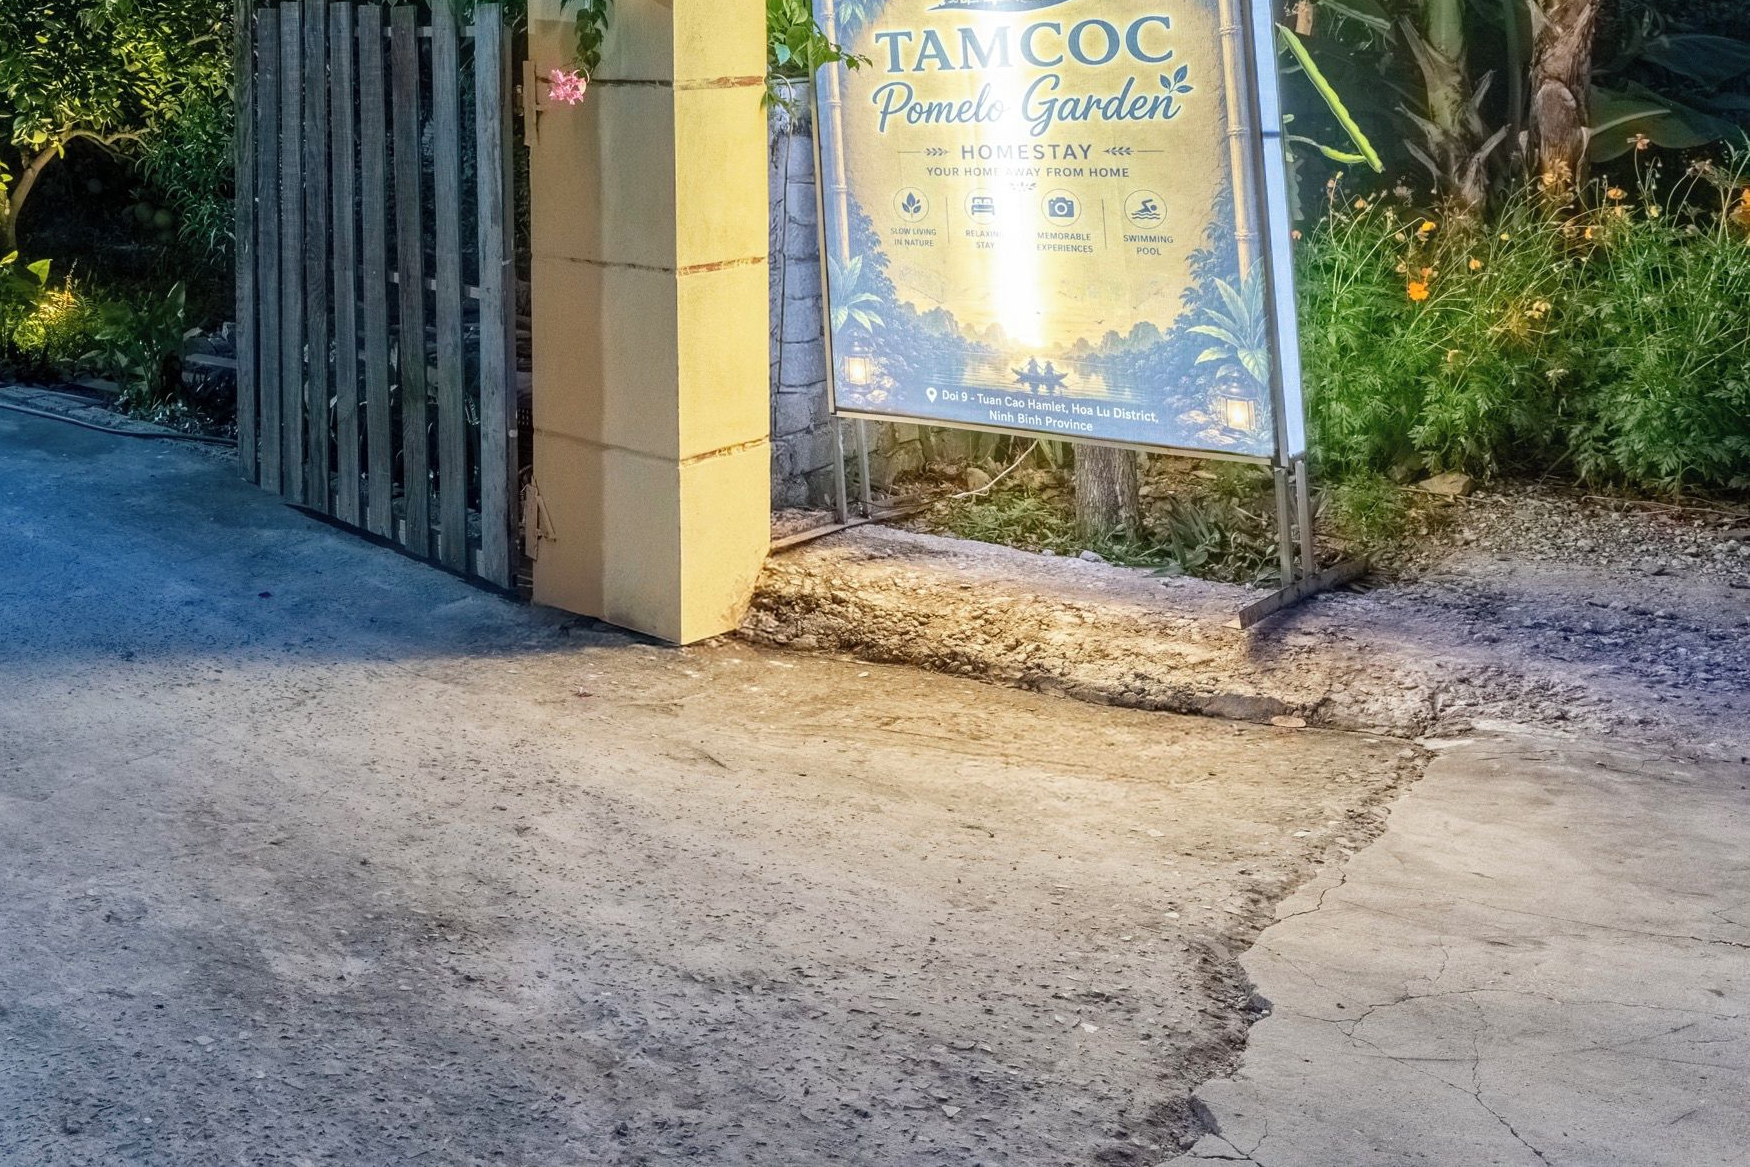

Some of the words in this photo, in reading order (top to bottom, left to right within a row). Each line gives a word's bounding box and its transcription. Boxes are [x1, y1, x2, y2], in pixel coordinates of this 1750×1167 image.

[874, 15, 1174, 73] TAMCOC
[872, 81, 1008, 134] Pomelo
[1022, 73, 1182, 137] Garden
[961, 143, 1093, 161] HOMESTAY
[925, 167, 960, 177] YOUR
[964, 167, 1000, 177] HOME
[1005, 167, 1041, 177] AWAY
[1046, 167, 1084, 178] FROM
[1088, 168, 1130, 178] HOME
[890, 228, 911, 236] SLOW
[912, 228, 937, 236] LIVING
[965, 229, 1003, 238] RELAXIN
[1037, 232, 1091, 241] MEMORABLE
[904, 239, 934, 247] NATURE
[1123, 234, 1174, 244] SWIMMING
[976, 241, 995, 249] STAY
[1036, 244, 1094, 253] EXPERIENCES
[1136, 247, 1162, 256] POOL
[942, 390, 959, 401] Doi
[961, 392, 968, 402] 9
[977, 393, 1002, 406] Tuan
[1004, 396, 1025, 409] Cao
[1028, 400, 1069, 414] Hamlet,
[1072, 403, 1094, 416] Hoa
[1097, 407, 1111, 417] Lu
[1113, 407, 1159, 424] District,
[989, 410, 1014, 423] Ninh
[1017, 413, 1042, 426] Binh
[1046, 415, 1093, 432] Province
